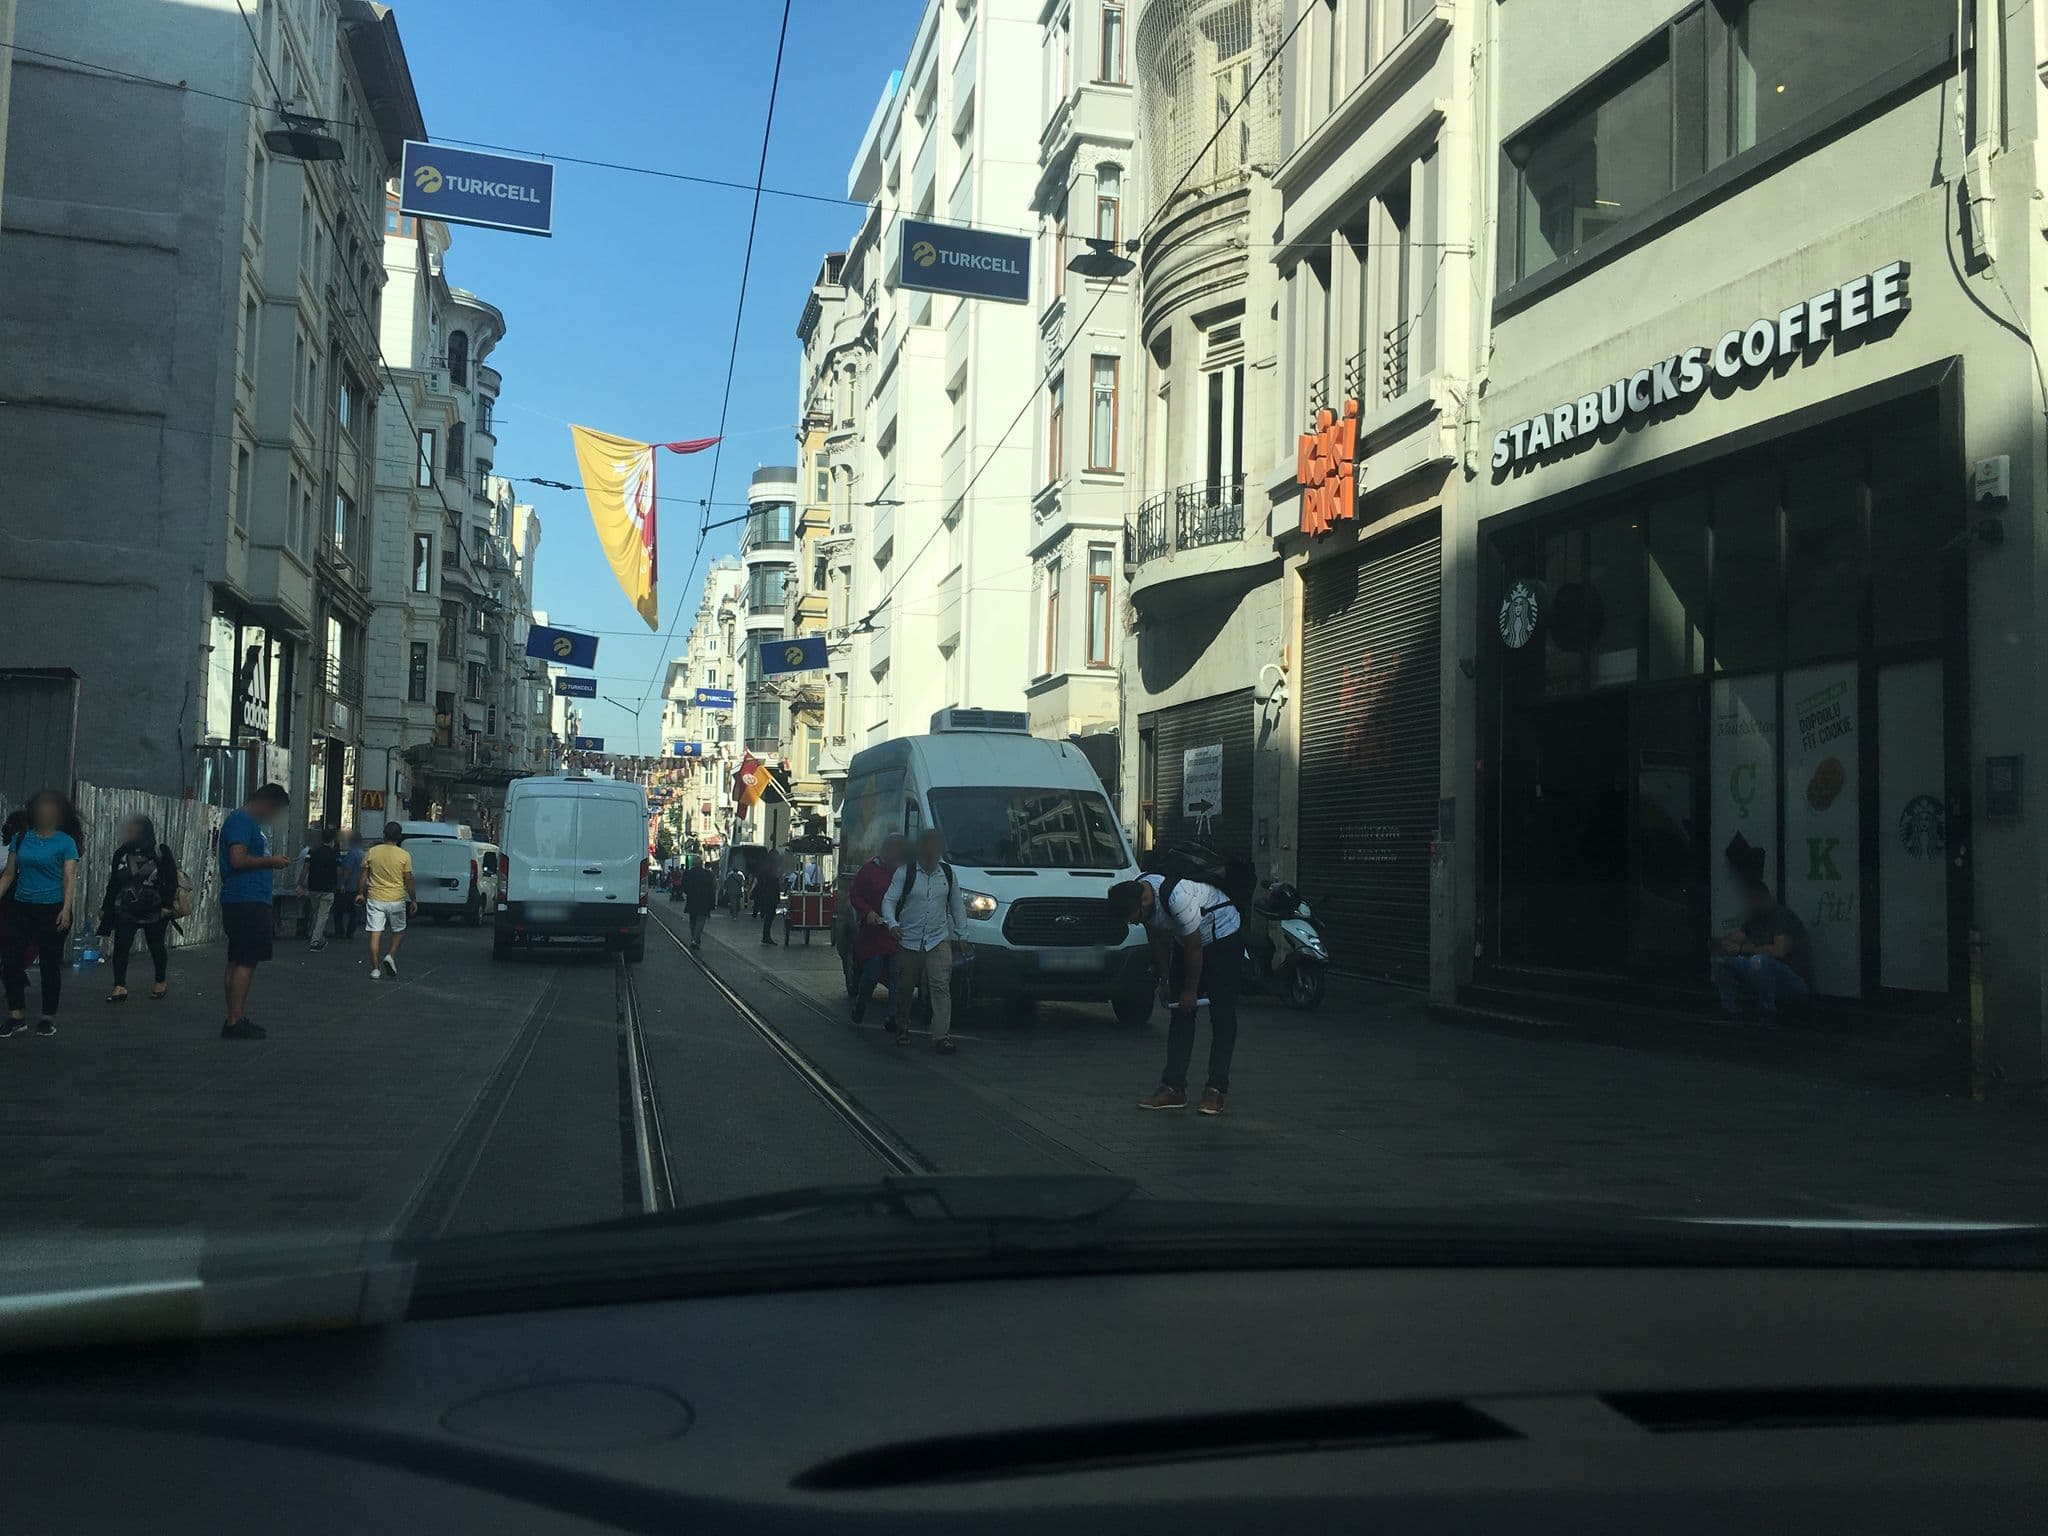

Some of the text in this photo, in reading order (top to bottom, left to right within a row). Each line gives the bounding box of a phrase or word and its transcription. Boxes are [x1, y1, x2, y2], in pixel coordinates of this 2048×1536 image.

[445, 174, 541, 205] TURKCELL
[939, 248, 1021, 276] TURKCELL
[1492, 260, 1912, 476] STARBUCKS COFFEE
[243, 696, 269, 732] adidas
[1806, 837, 1842, 881] K
